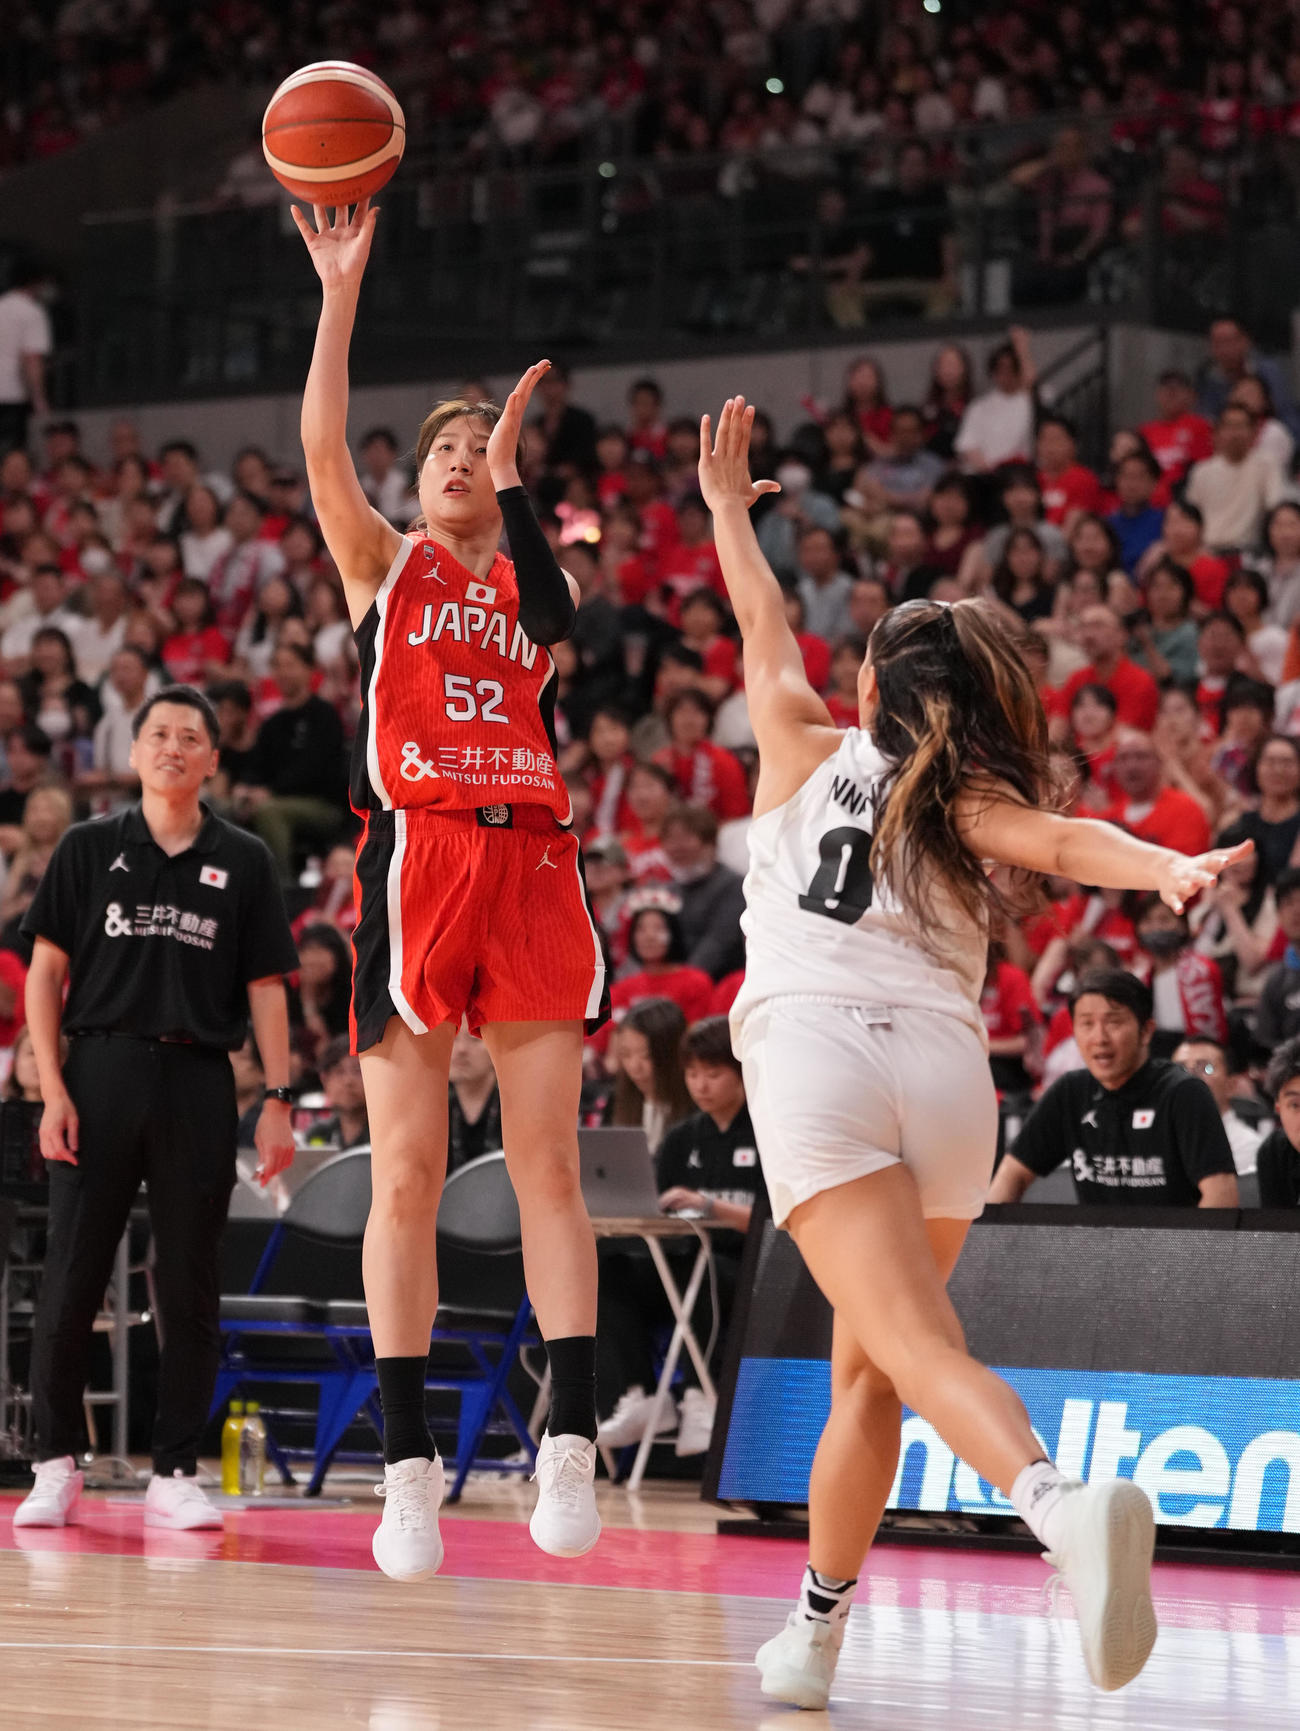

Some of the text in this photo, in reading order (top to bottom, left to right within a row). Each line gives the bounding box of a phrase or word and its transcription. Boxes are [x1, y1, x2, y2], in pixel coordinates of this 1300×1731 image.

[407, 602, 538, 671] JAPAN
[443, 673, 511, 725] 52
[438, 746, 554, 777] 三井不動産
[441, 769, 556, 791] MITSUI FUDOSAN
[798, 826, 873, 926] 0
[134, 904, 219, 940] 三井不動産
